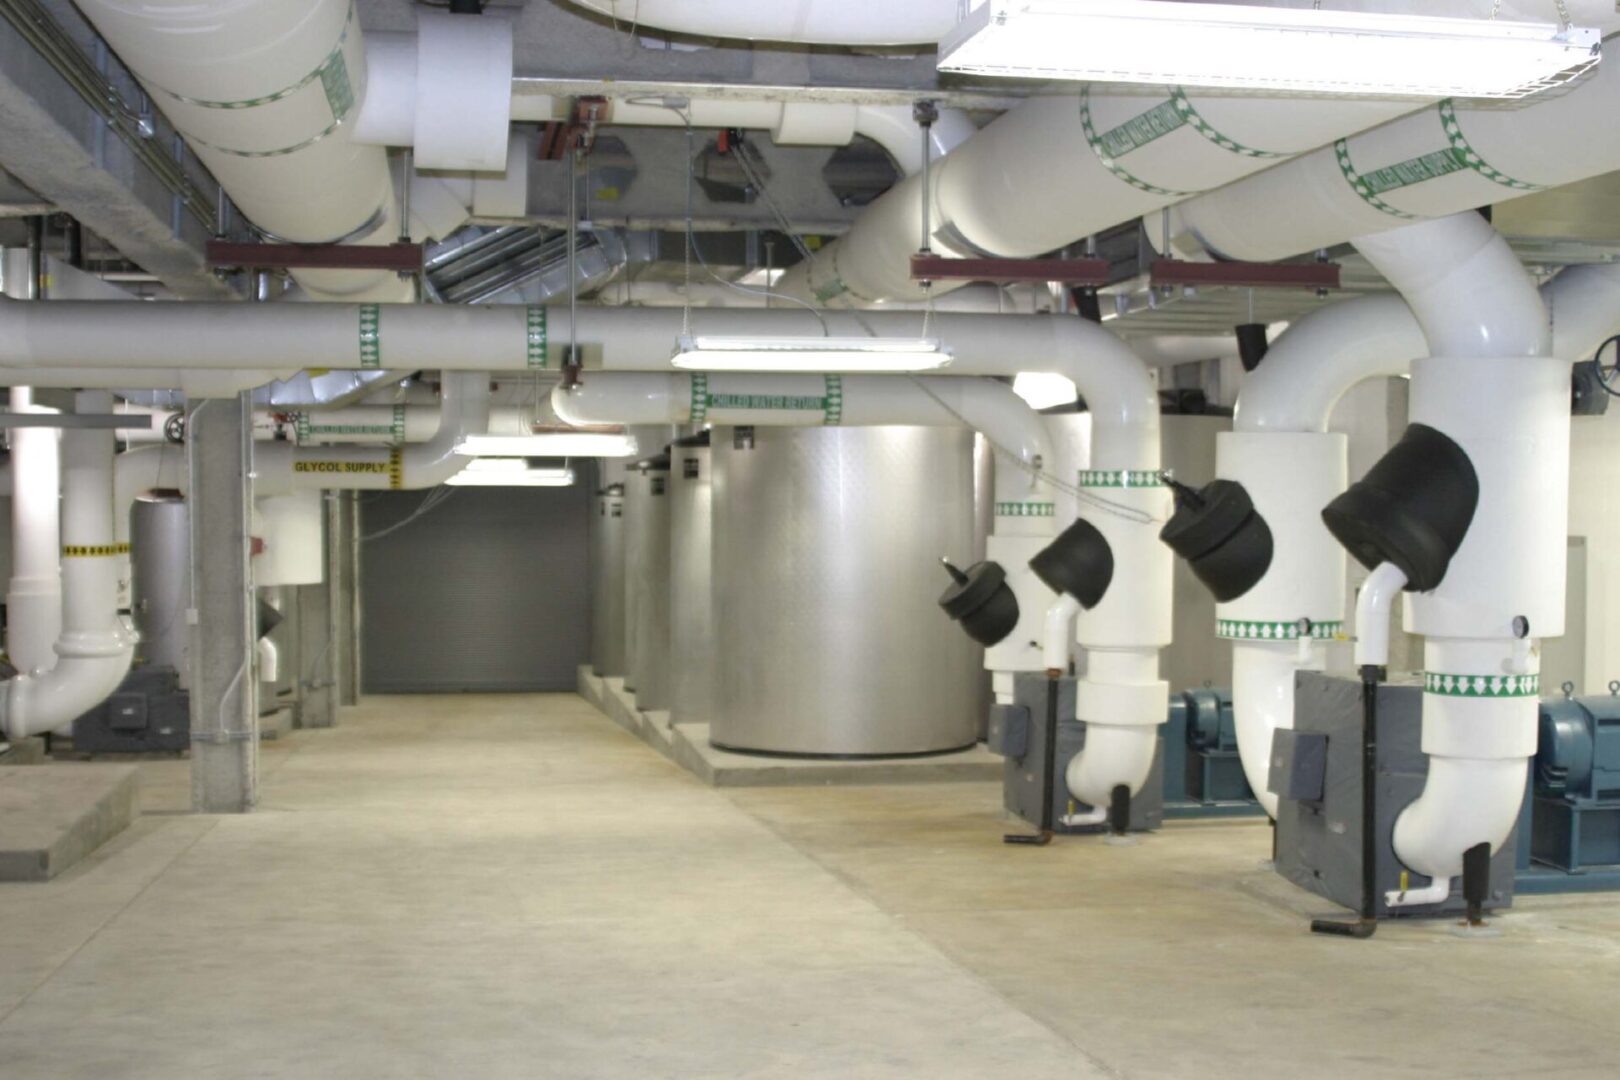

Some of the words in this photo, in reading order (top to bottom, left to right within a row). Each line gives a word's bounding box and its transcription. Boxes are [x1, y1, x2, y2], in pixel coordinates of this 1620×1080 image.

[1123, 115, 1156, 145] WATER
[1362, 167, 1402, 193] CHILLED
[1391, 158, 1431, 184] WATER
[1420, 148, 1463, 175] SUPPLY
[712, 393, 748, 408] CHILLED
[751, 394, 782, 409] WATER
[785, 395, 821, 410] RETURN
[295, 462, 342, 473] GLYCOL
[345, 462, 385, 473] SUPPLY
